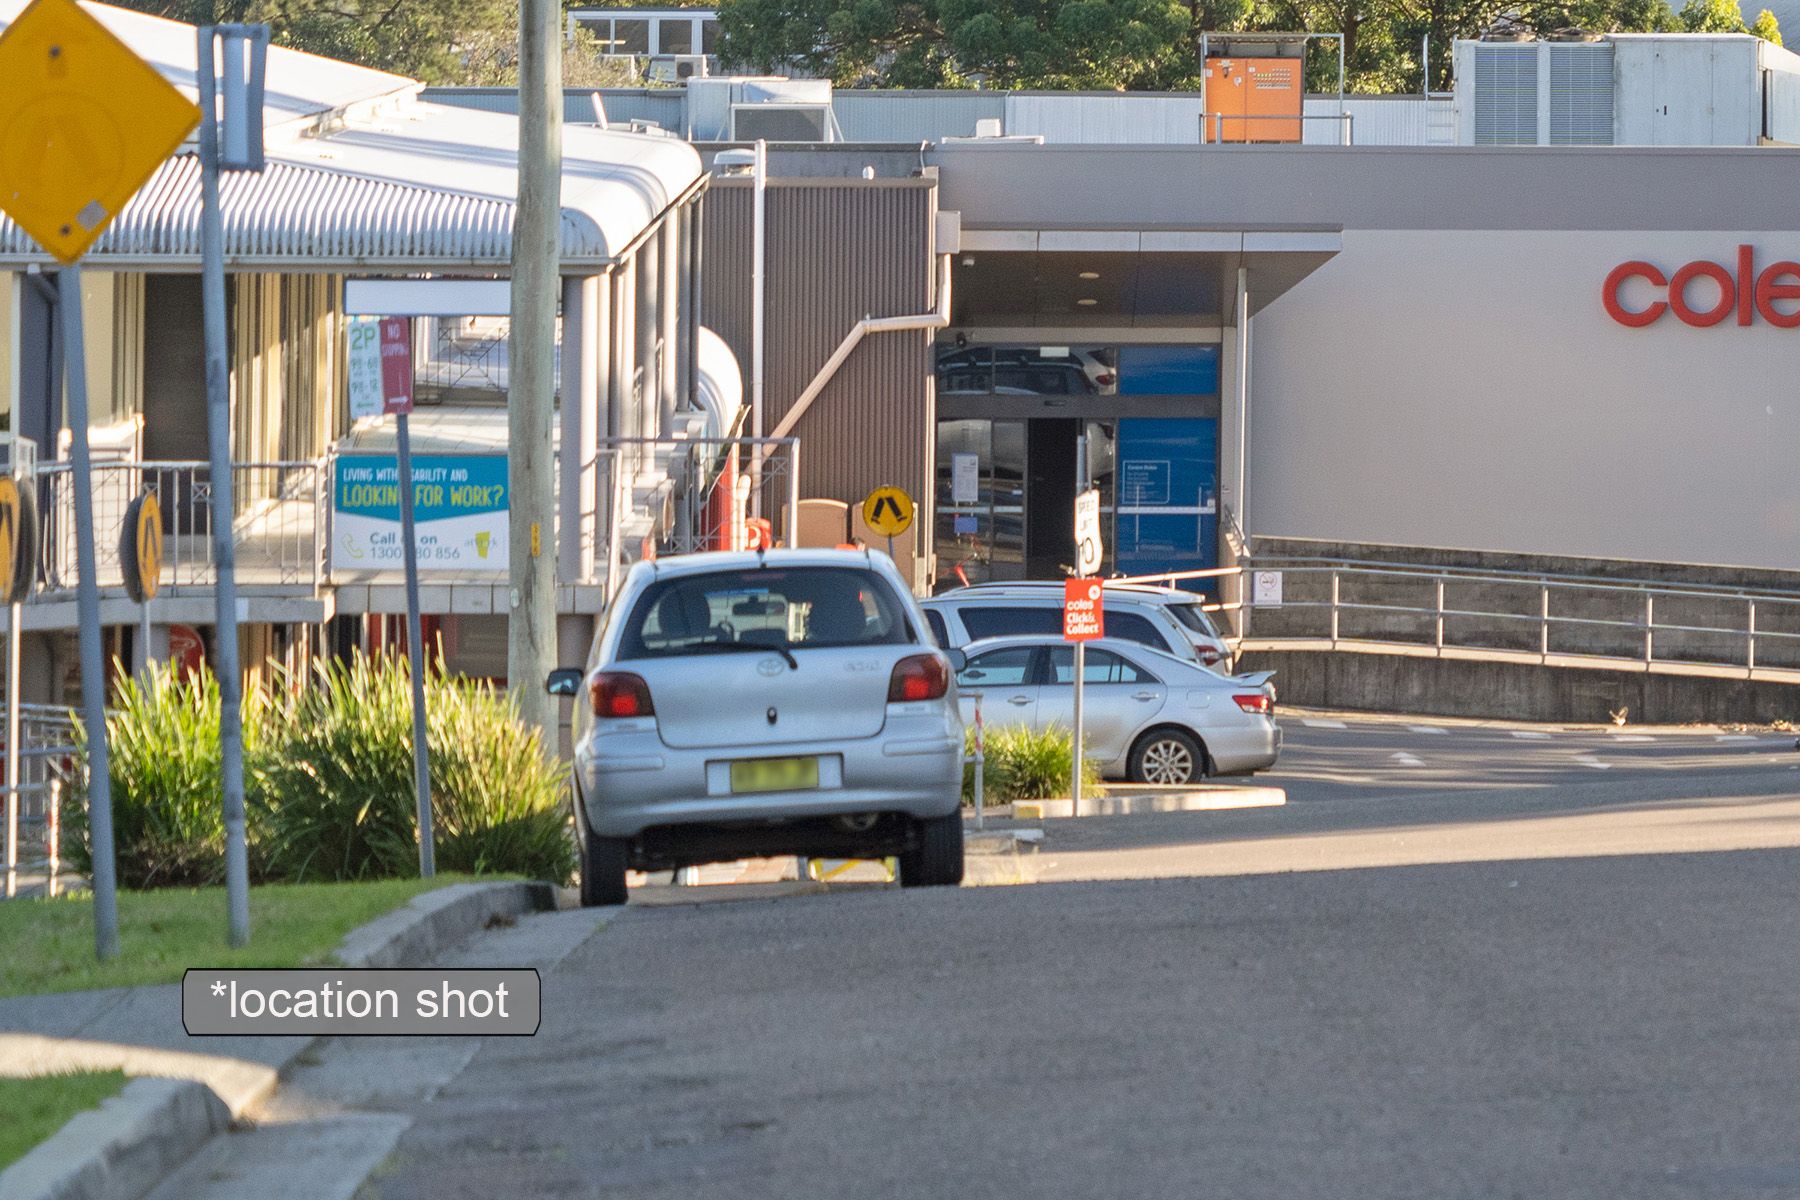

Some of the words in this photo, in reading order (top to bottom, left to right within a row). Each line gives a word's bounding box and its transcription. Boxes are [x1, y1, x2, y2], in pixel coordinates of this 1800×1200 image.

[351, 327, 376, 350] 2P
[387, 324, 401, 340] NO
[343, 468, 373, 482] LIVING
[376, 468, 398, 482] WITH
[411, 468, 447, 482] SABILITY
[450, 468, 468, 482] AND
[342, 485, 401, 507] LOOKIN
[415, 485, 443, 507] FOR
[450, 485, 504, 507] WORK?
[370, 532, 395, 546] Call
[420, 535, 438, 546] on
[370, 547, 401, 560] 1300
[415, 547, 431, 560] 80
[436, 547, 460, 560] 856
[1067, 600, 1094, 611] coles
[1066, 624, 1099, 636] Collect
